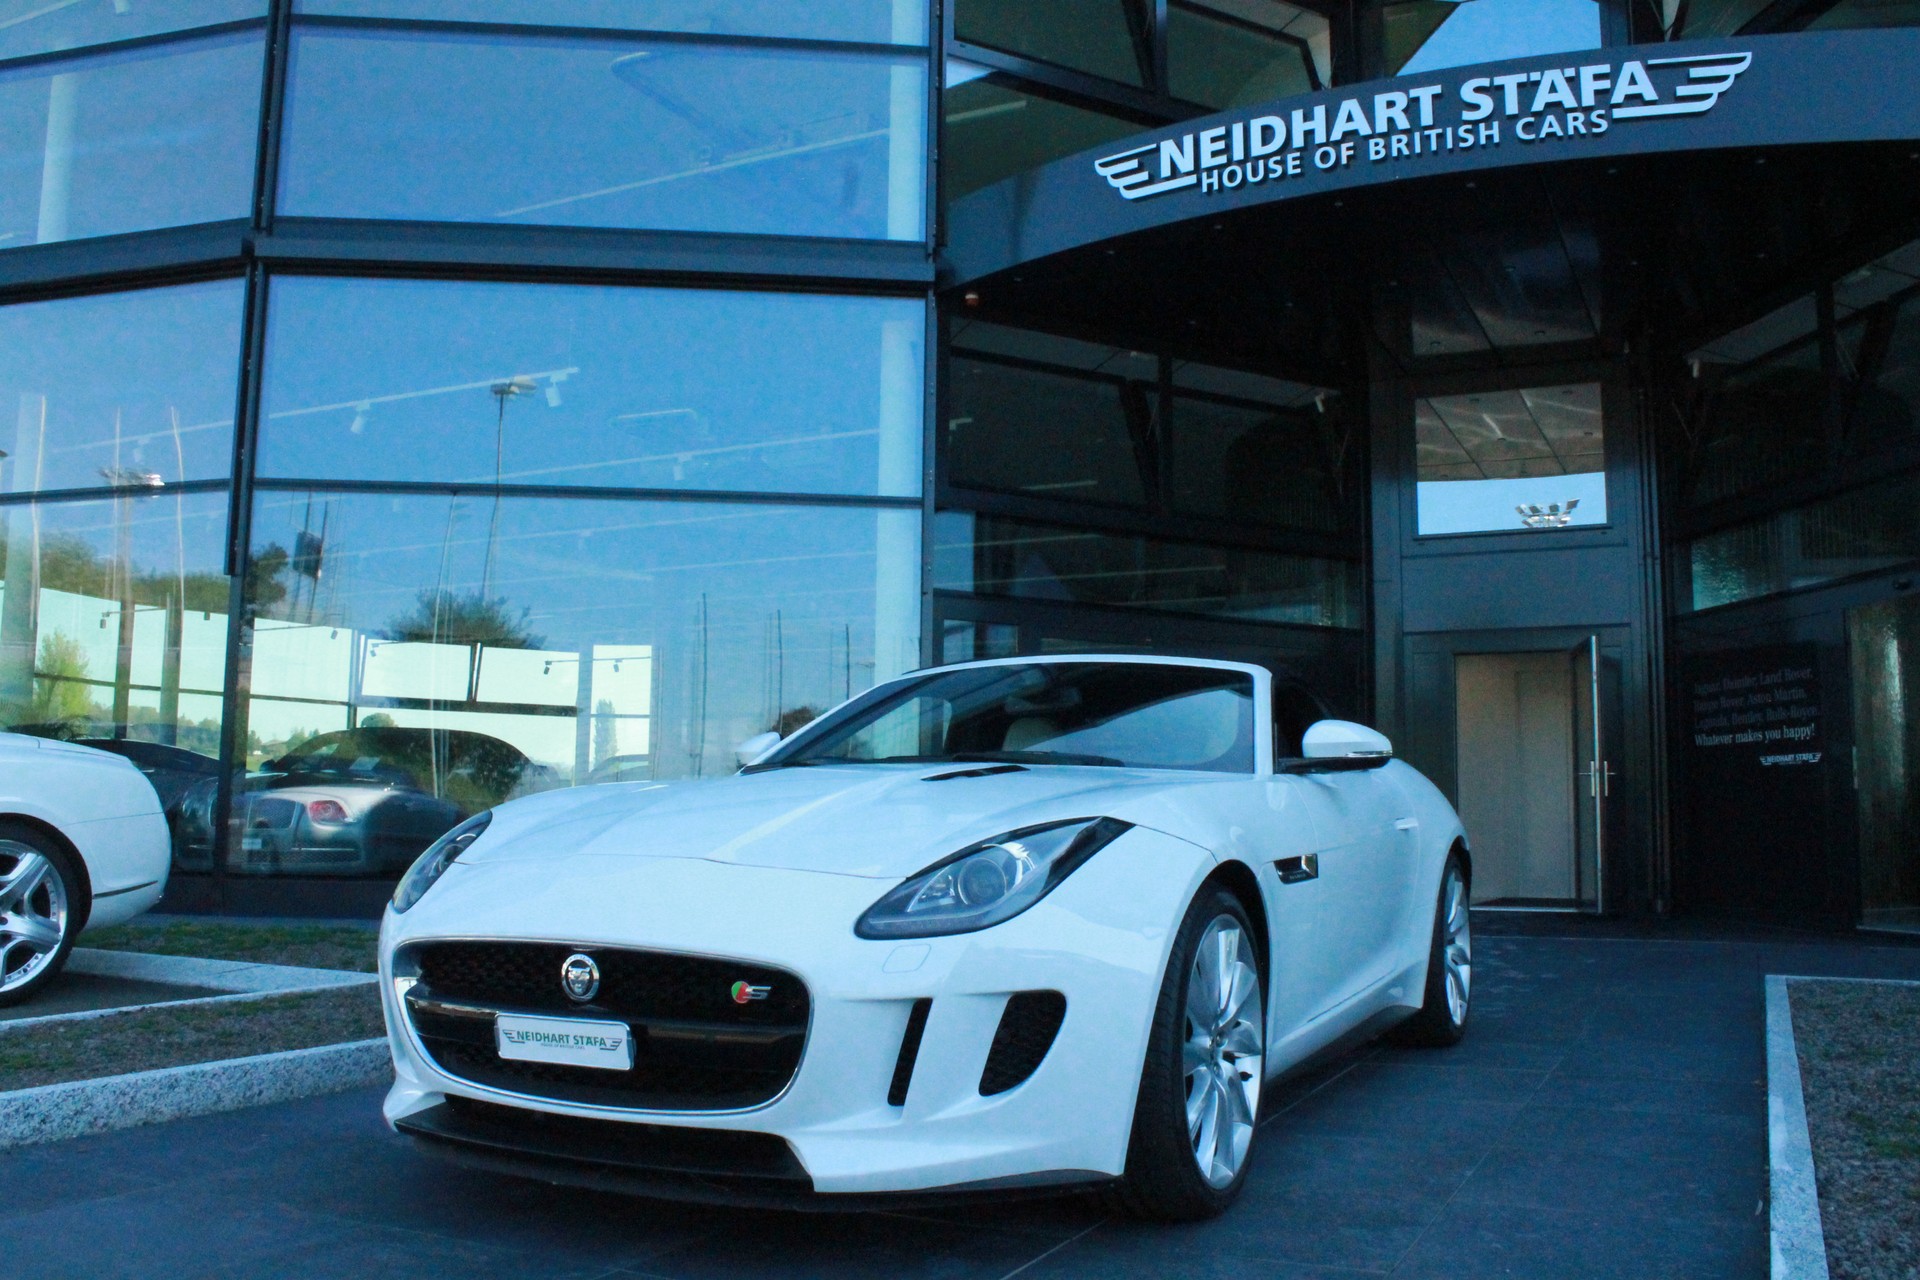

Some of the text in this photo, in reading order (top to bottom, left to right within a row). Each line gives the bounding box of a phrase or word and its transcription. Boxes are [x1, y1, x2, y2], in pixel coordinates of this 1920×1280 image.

[1159, 60, 1659, 176] NEIDHART STÄFA
[1202, 110, 1608, 193] HOUSE OF BRITISH CARS
[1760, 670, 1782, 685] Land
[1695, 723, 1815, 747] Whatever makes you happy!
[516, 1030, 571, 1044] NEIDHART
